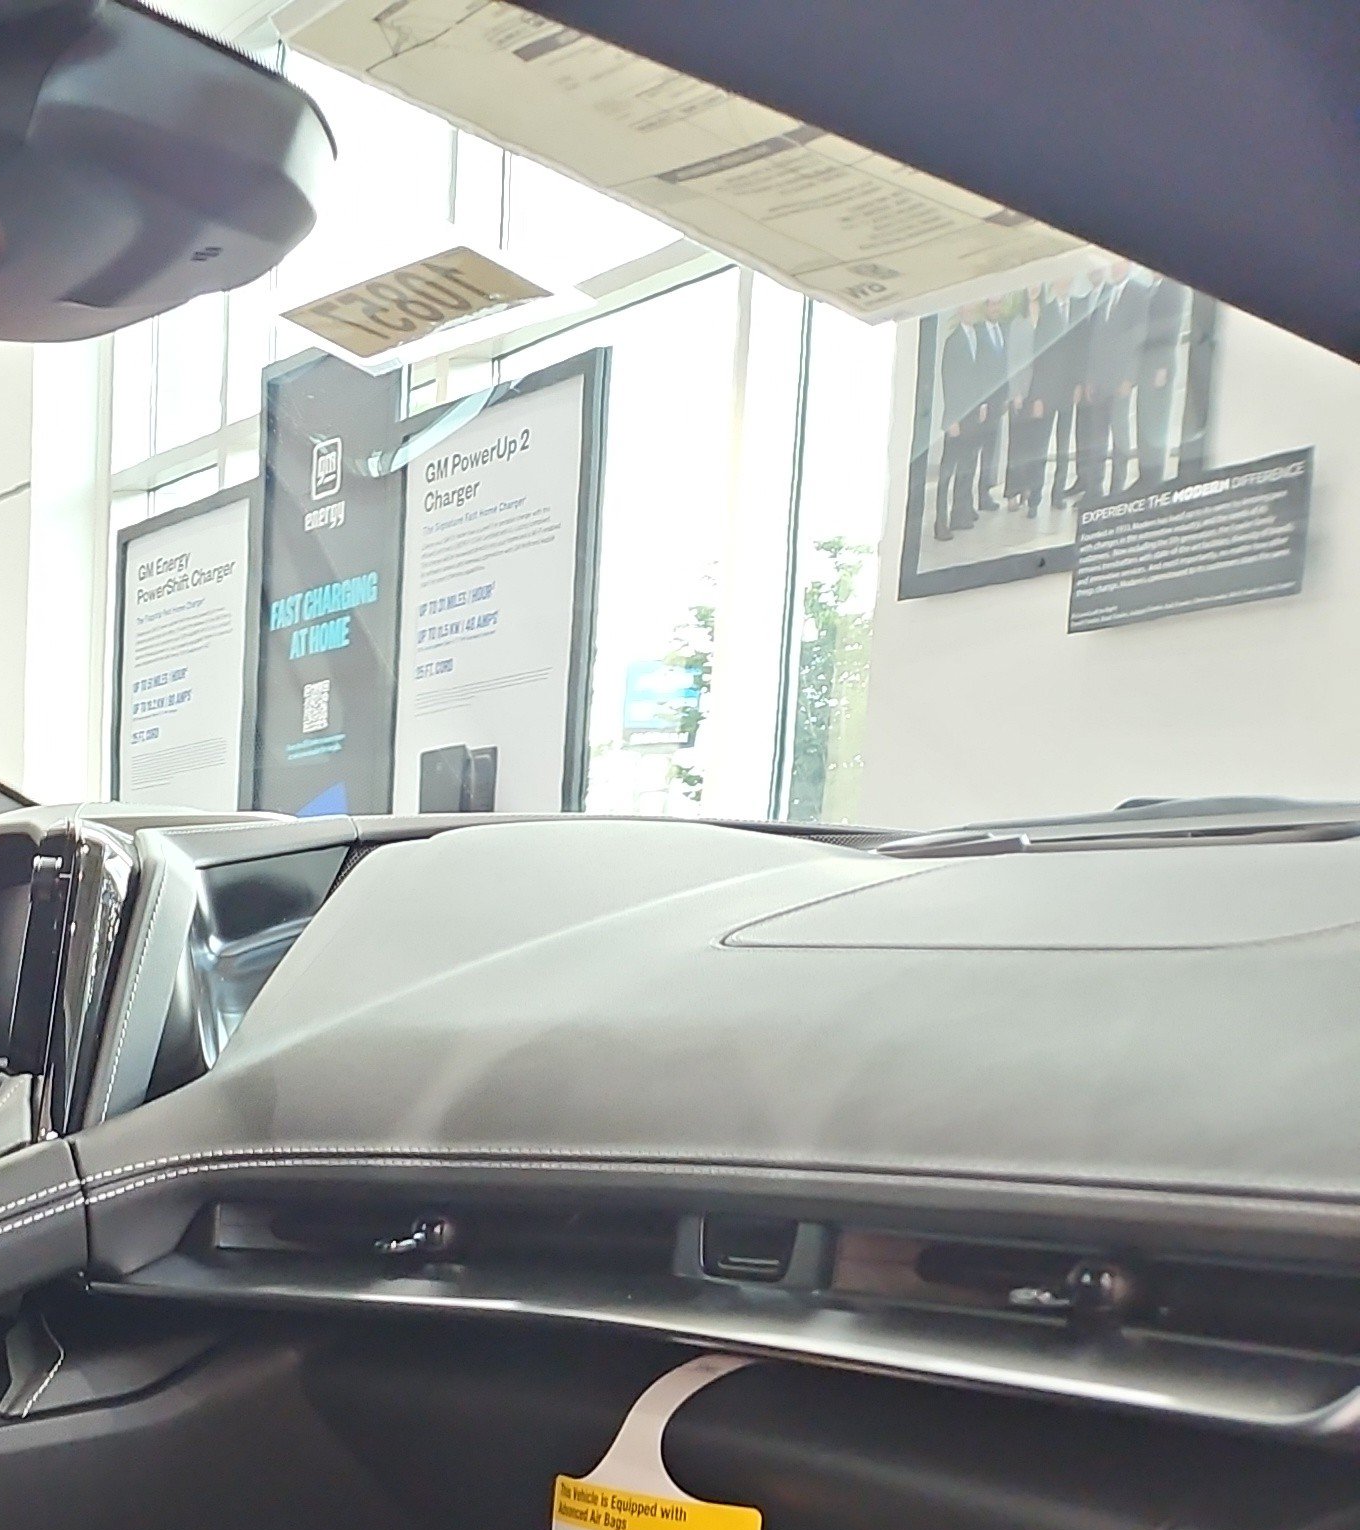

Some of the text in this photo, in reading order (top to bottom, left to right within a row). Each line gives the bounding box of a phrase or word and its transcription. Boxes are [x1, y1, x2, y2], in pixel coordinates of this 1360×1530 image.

[425, 428, 530, 484] GM PowerUp 2
[424, 481, 480, 513] Charger
[1081, 460, 1307, 525] EXPERIENCE THE MODERN DIFFERENCE
[304, 500, 346, 532] energy
[137, 561, 236, 605] PowerShift Charger
[138, 552, 191, 582] GM Energy
[270, 571, 379, 632] FAST CHARGING
[289, 615, 351, 660] AT HOME
[558, 1500, 588, 1522] Advanced
[590, 1508, 602, 1524] Air
[573, 1486, 600, 1506] Vehicle
[600, 1492, 608, 1508] is
[610, 1494, 658, 1518] Equipped
[660, 1504, 687, 1522] with
